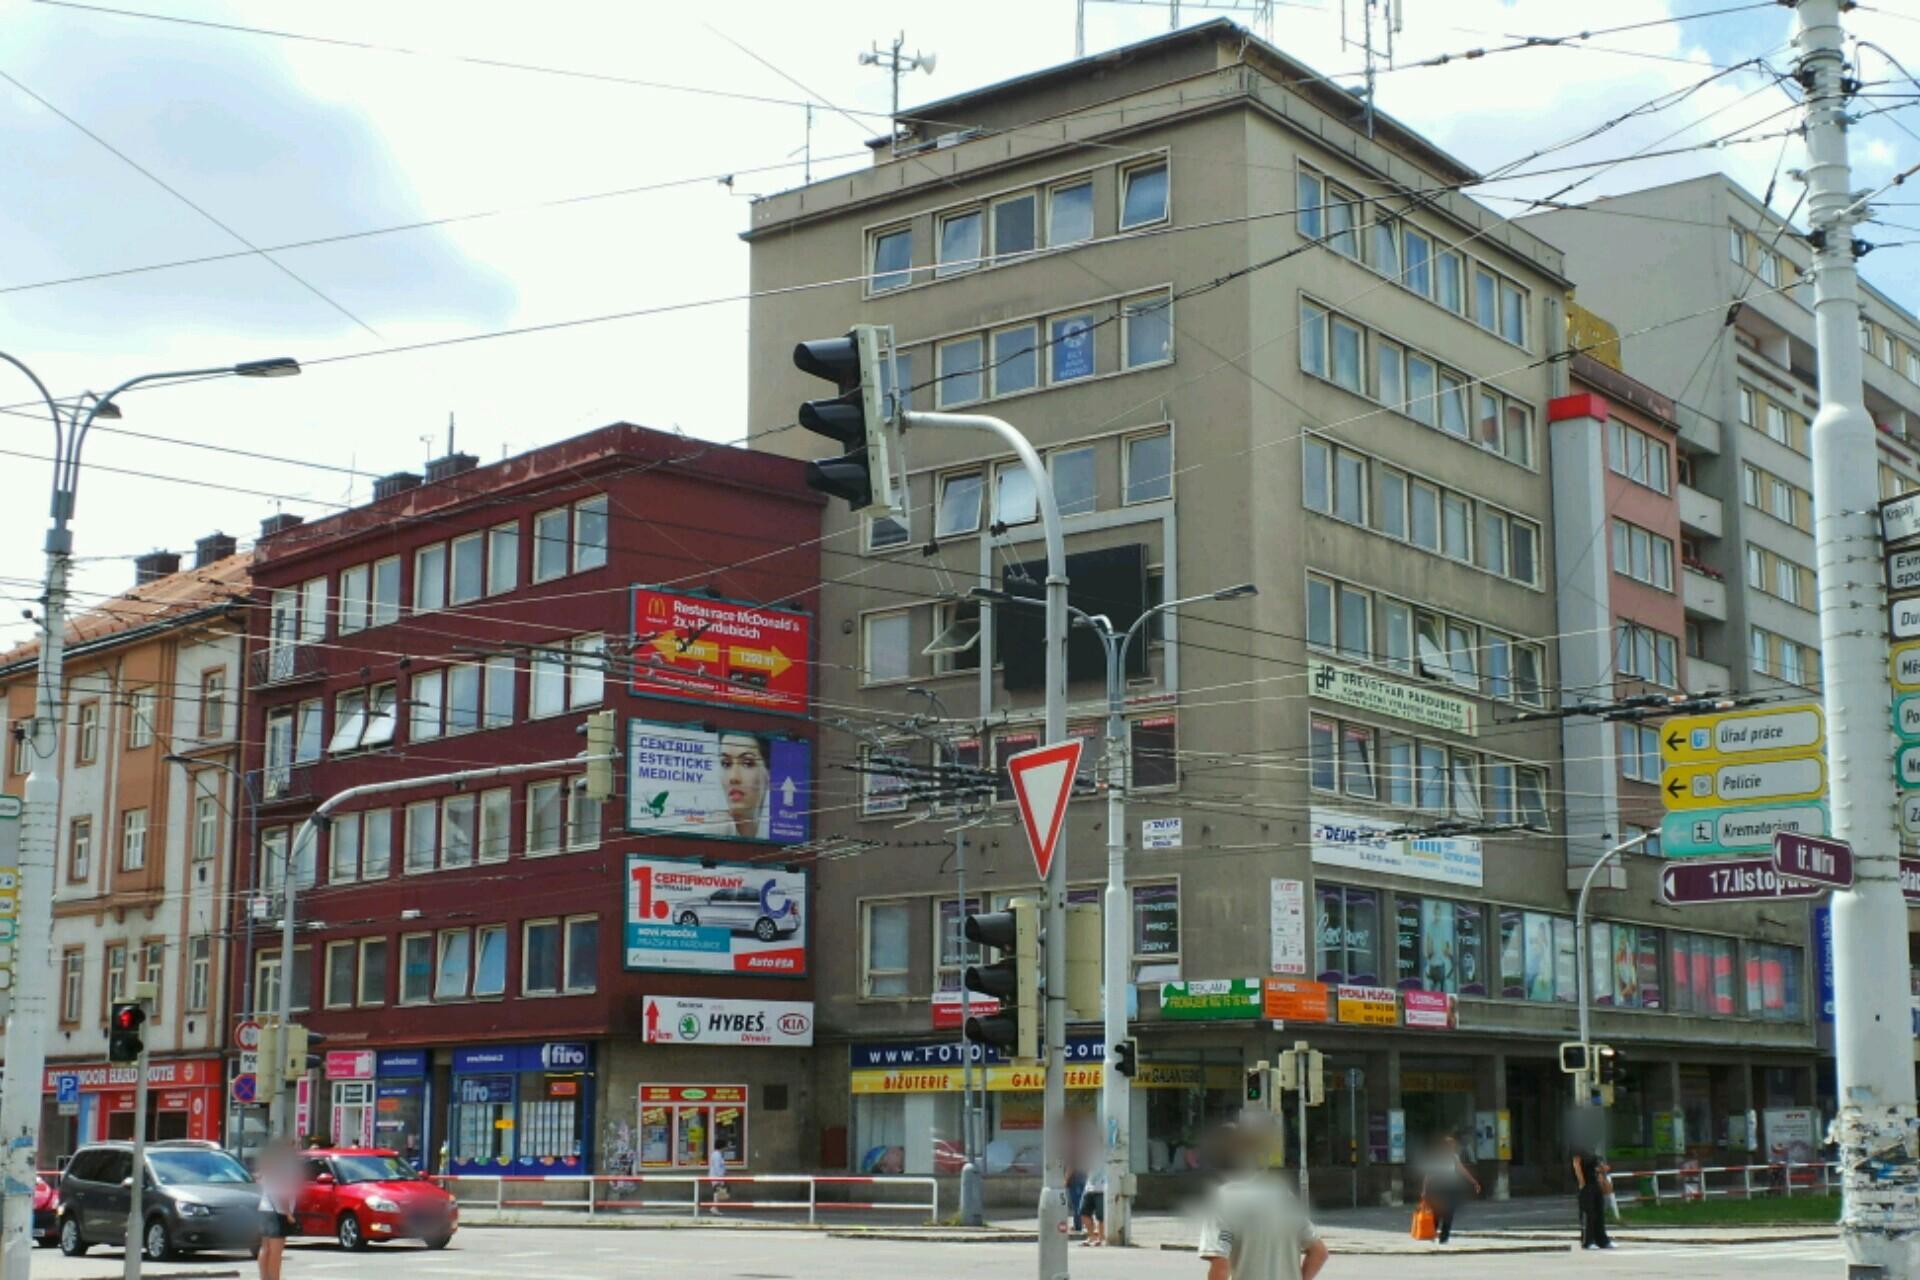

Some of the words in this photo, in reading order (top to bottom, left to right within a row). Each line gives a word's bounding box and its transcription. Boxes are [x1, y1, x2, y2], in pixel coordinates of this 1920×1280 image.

[673, 600, 735, 621] Restaurace
[1409, 690, 1463, 715] PARDUBICE
[1750, 726, 1784, 744] práce
[640, 736, 704, 754] CENTRUM
[638, 767, 704, 783] MEDICÍNY
[1723, 775, 1762, 791] Policie
[1724, 819, 1800, 838] Krematorium
[654, 872, 744, 889] CERTIFIKOVANÝ
[631, 866, 669, 919] 1.
[708, 1011, 765, 1032] HYBEŠ
[782, 1019, 805, 1031] KIA
[551, 1045, 585, 1064] firo
[883, 1074, 950, 1090] BIŽUTERIE
[1011, 1070, 1101, 1088] GALTERIE
[462, 1080, 489, 1101] firo
